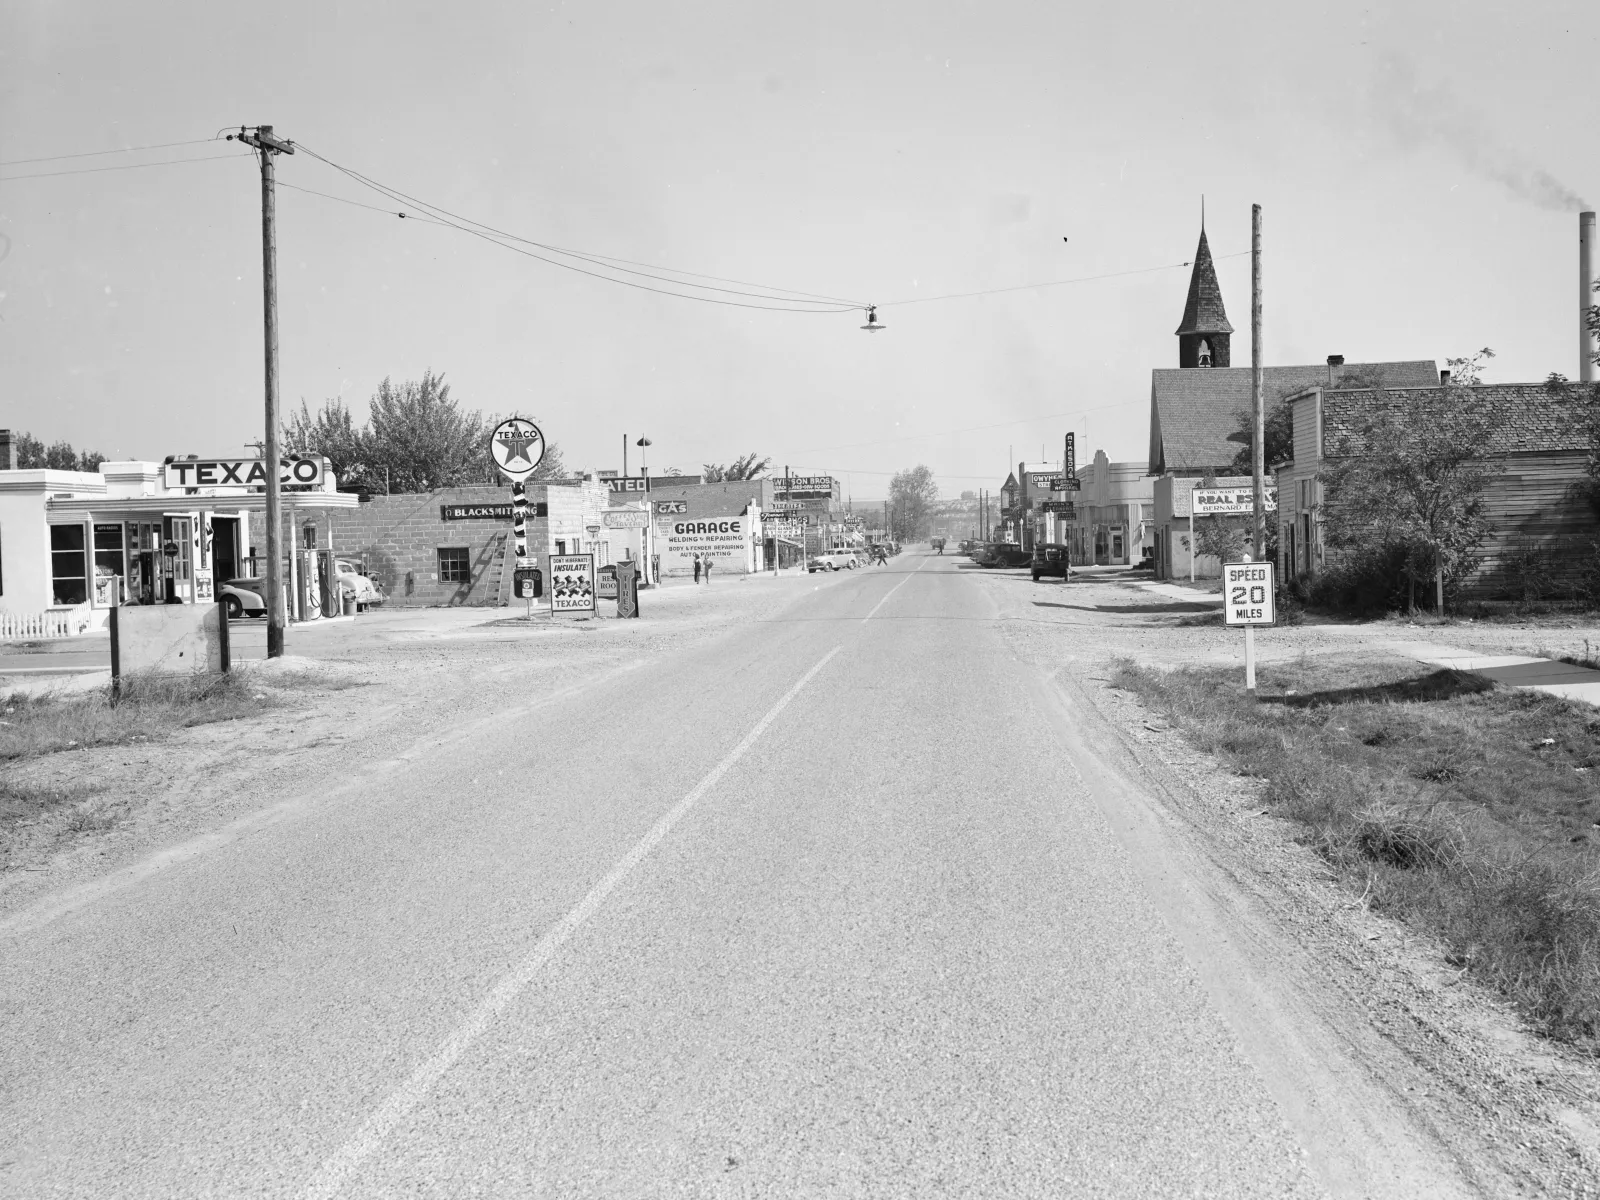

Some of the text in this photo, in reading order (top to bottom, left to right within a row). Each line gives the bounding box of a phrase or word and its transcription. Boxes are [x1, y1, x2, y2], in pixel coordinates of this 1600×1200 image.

[498, 431, 538, 440] TEXACO
[171, 459, 318, 485] TEXACO
[607, 479, 647, 491] ATED
[1198, 495, 1234, 504] REAL
[455, 506, 538, 517] BLACKSMITNG
[658, 501, 687, 513] GAS
[674, 521, 741, 534] GARAGE
[705, 535, 744, 543] REPAIRING
[554, 563, 590, 572] INSULATE!
[1230, 569, 1266, 582] SPEED
[600, 582, 617, 590] ROO
[622, 574, 630, 613] TIRES
[1232, 586, 1265, 605] 20
[556, 599, 591, 608] TEXACO
[1236, 608, 1263, 619] MILES
